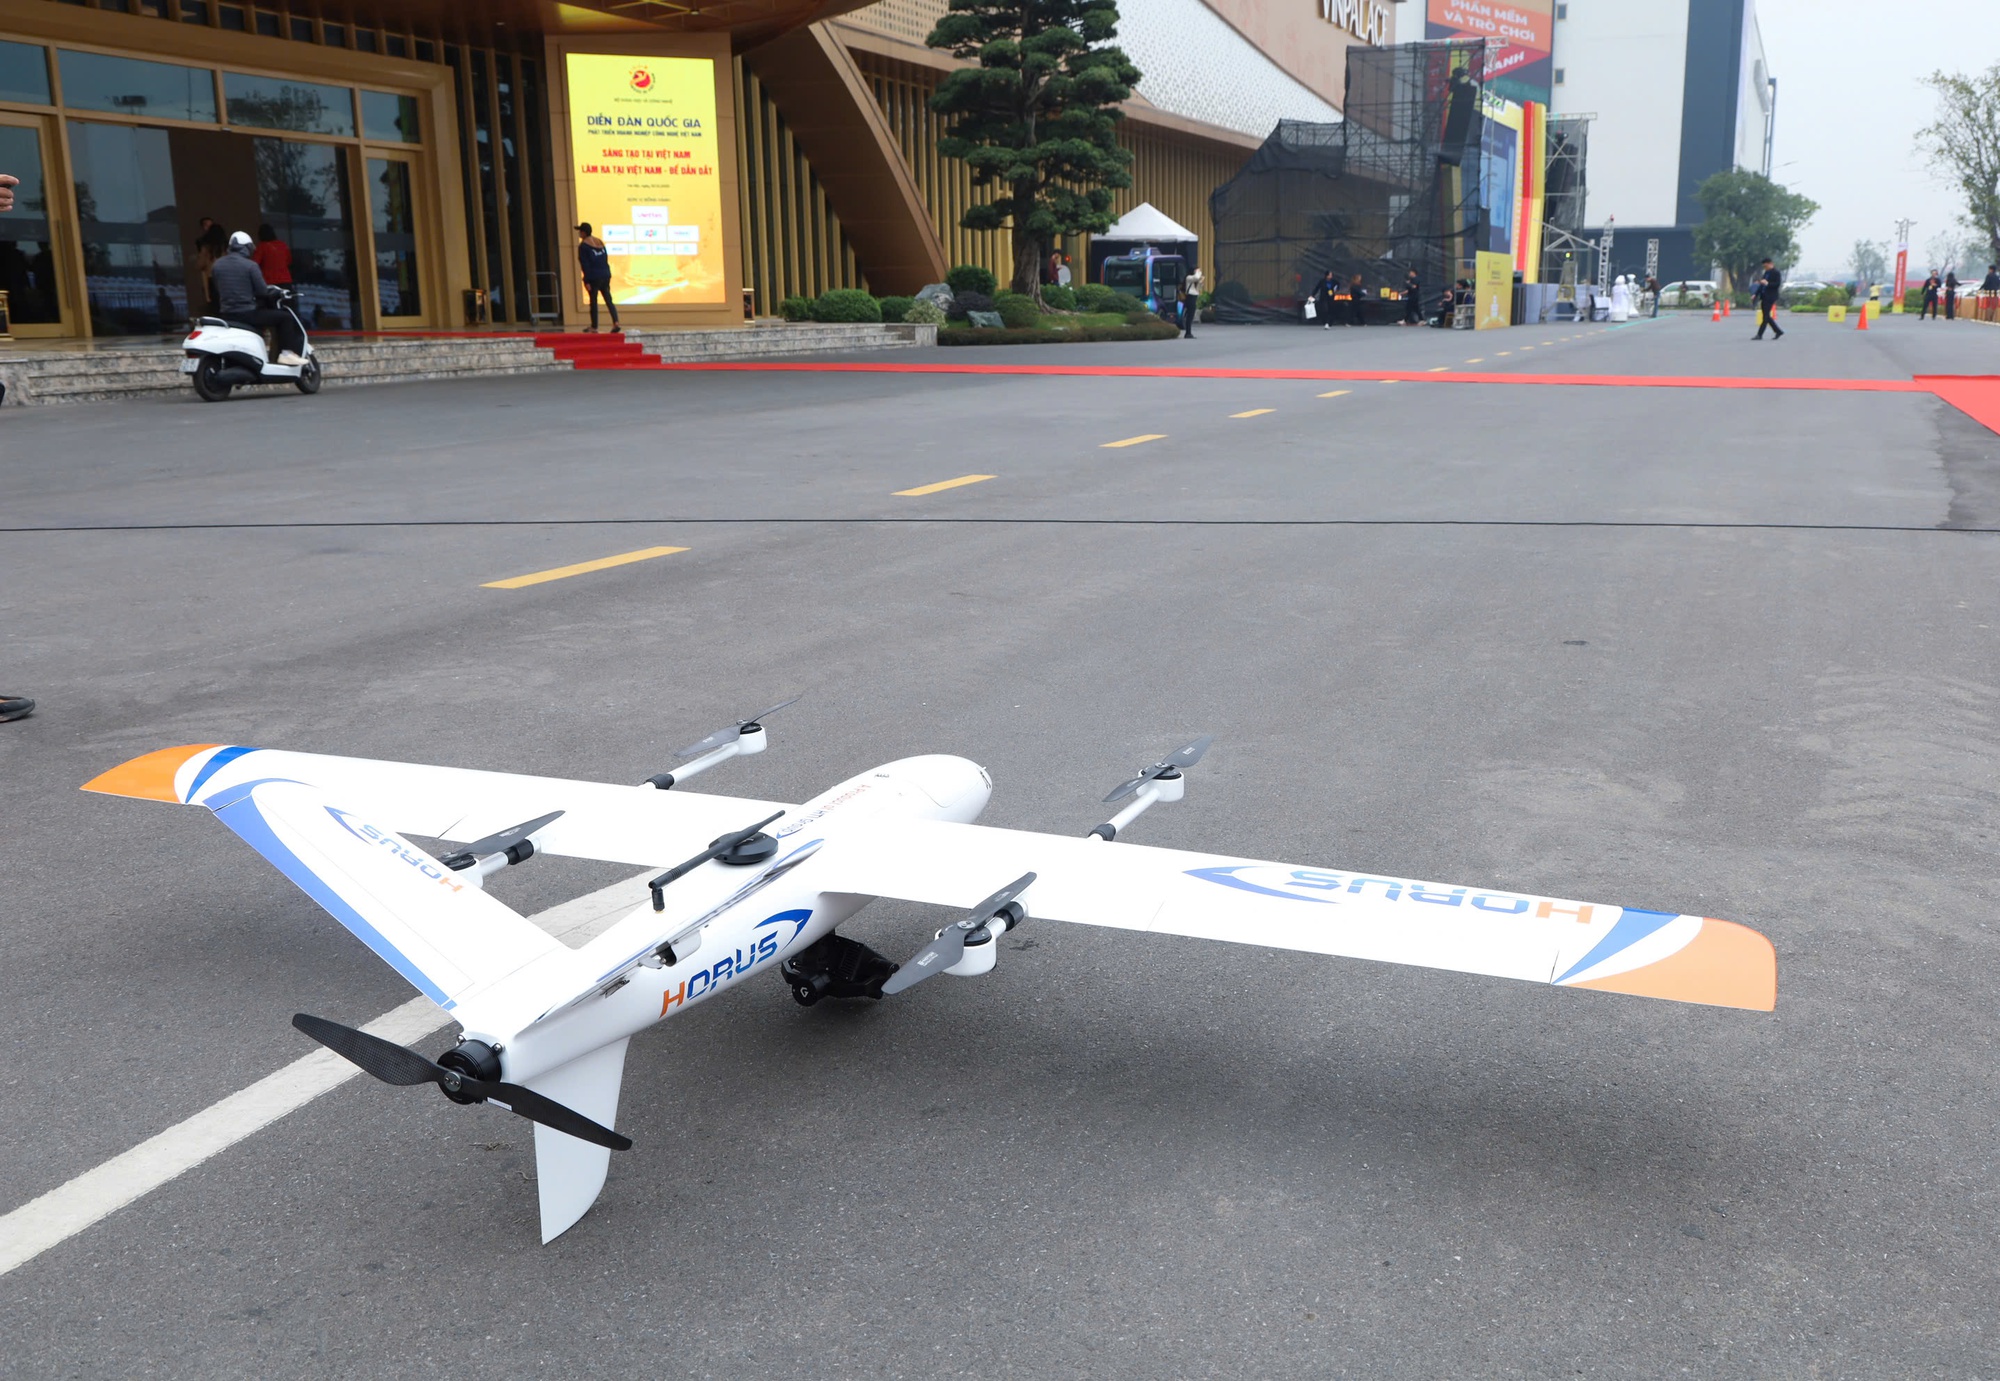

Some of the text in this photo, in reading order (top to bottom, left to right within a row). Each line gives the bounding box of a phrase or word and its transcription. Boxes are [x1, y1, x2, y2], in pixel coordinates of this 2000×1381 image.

[1499, 24, 1536, 42] CHƠI
[683, 118, 701, 128] GIA
[673, 151, 691, 159] NAM
[601, 165, 610, 174] RA
[644, 166, 662, 175] NAM
[358, 823, 464, 893] HORUS
[1283, 870, 1595, 924] HORUS
[658, 930, 780, 1019] HORUS
